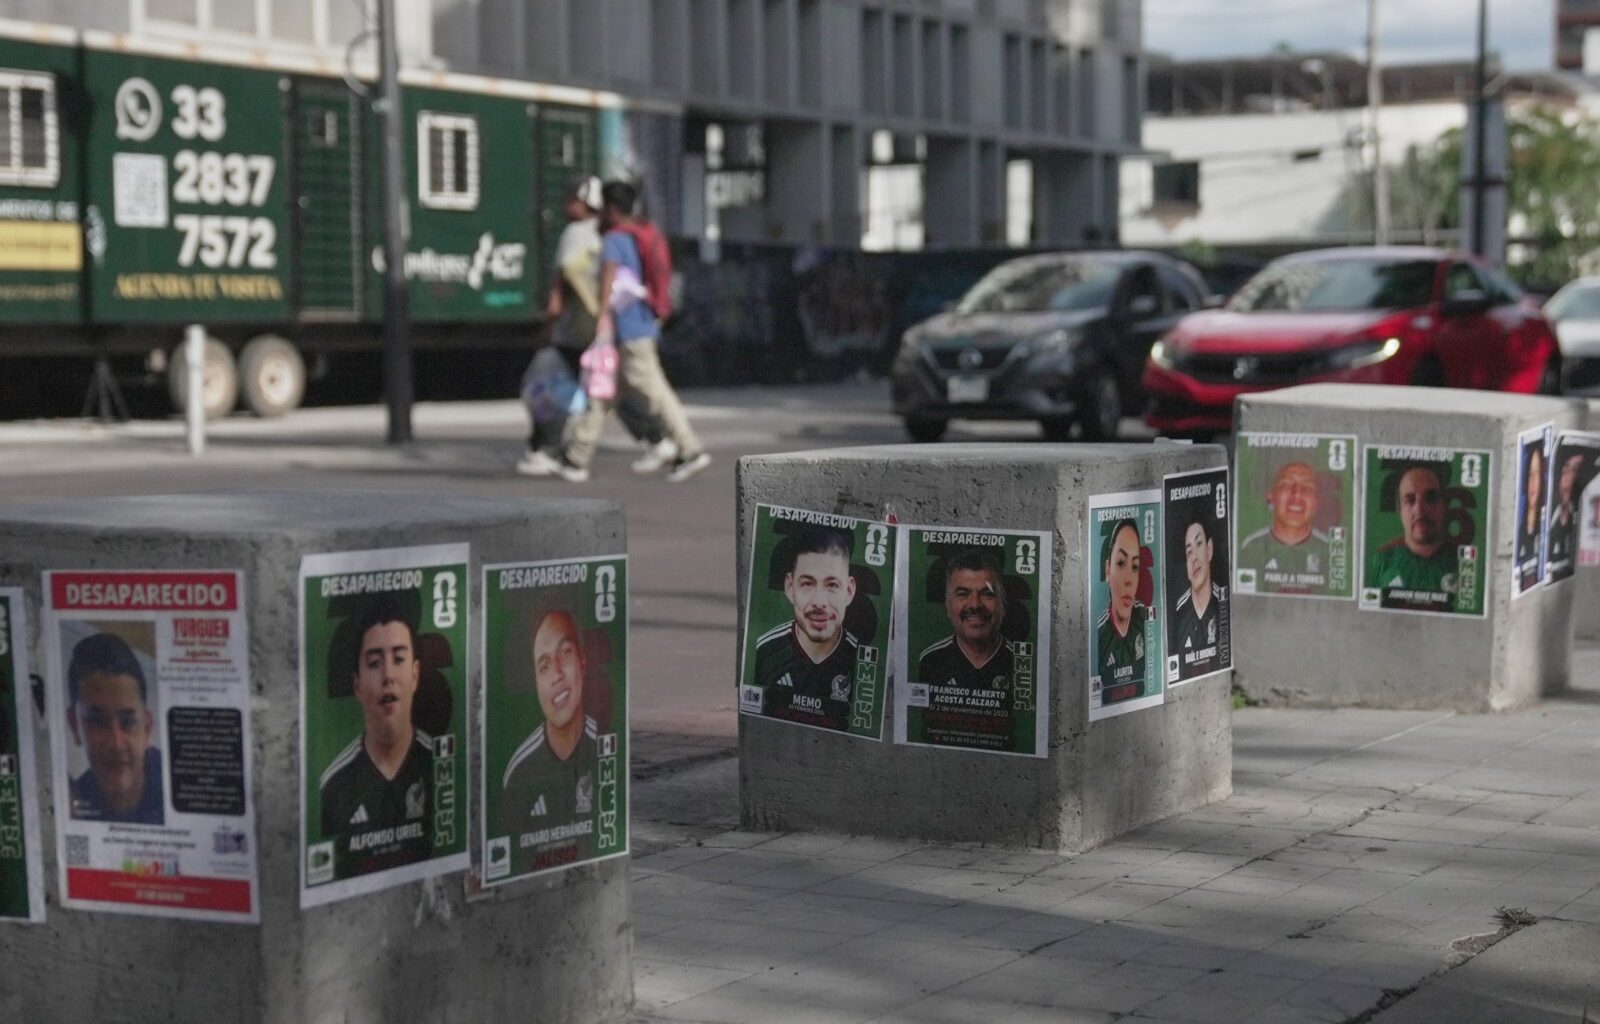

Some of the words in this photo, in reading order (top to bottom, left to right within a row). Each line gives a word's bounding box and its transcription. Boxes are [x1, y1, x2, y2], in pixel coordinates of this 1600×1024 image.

[171, 84, 226, 141] 33
[173, 149, 276, 207] 2837
[173, 214, 277, 268] 7572
[116, 272, 192, 300] AGENDA
[217, 273, 282, 300] VISITA
[1248, 434, 1318, 448] DESAPARECIDO
[1377, 447, 1454, 462] DESAPARECIDO
[1170, 483, 1211, 501] DESAPARECIDO
[769, 506, 858, 531] DESAPARECIDO
[1098, 507, 1139, 522] DESAPARECIDA
[922, 532, 1005, 547] DESAPARECIDO
[321, 569, 423, 597] DESAPARECIDO
[500, 564, 587, 590] DESAPARECIDO
[66, 583, 226, 606] DESAPARECIDO
[1114, 665, 1133, 678] LAURITA
[793, 694, 822, 709] MEMO
[929, 685, 970, 697] FRANCISCO
[972, 689, 1005, 699] ALBERTO
[935, 696, 963, 704] ACOSTA
[966, 697, 1000, 708] CALZADA
[349, 827, 394, 852] ALFONSO
[396, 822, 424, 841] URIEL
[520, 829, 549, 849] GENARO
